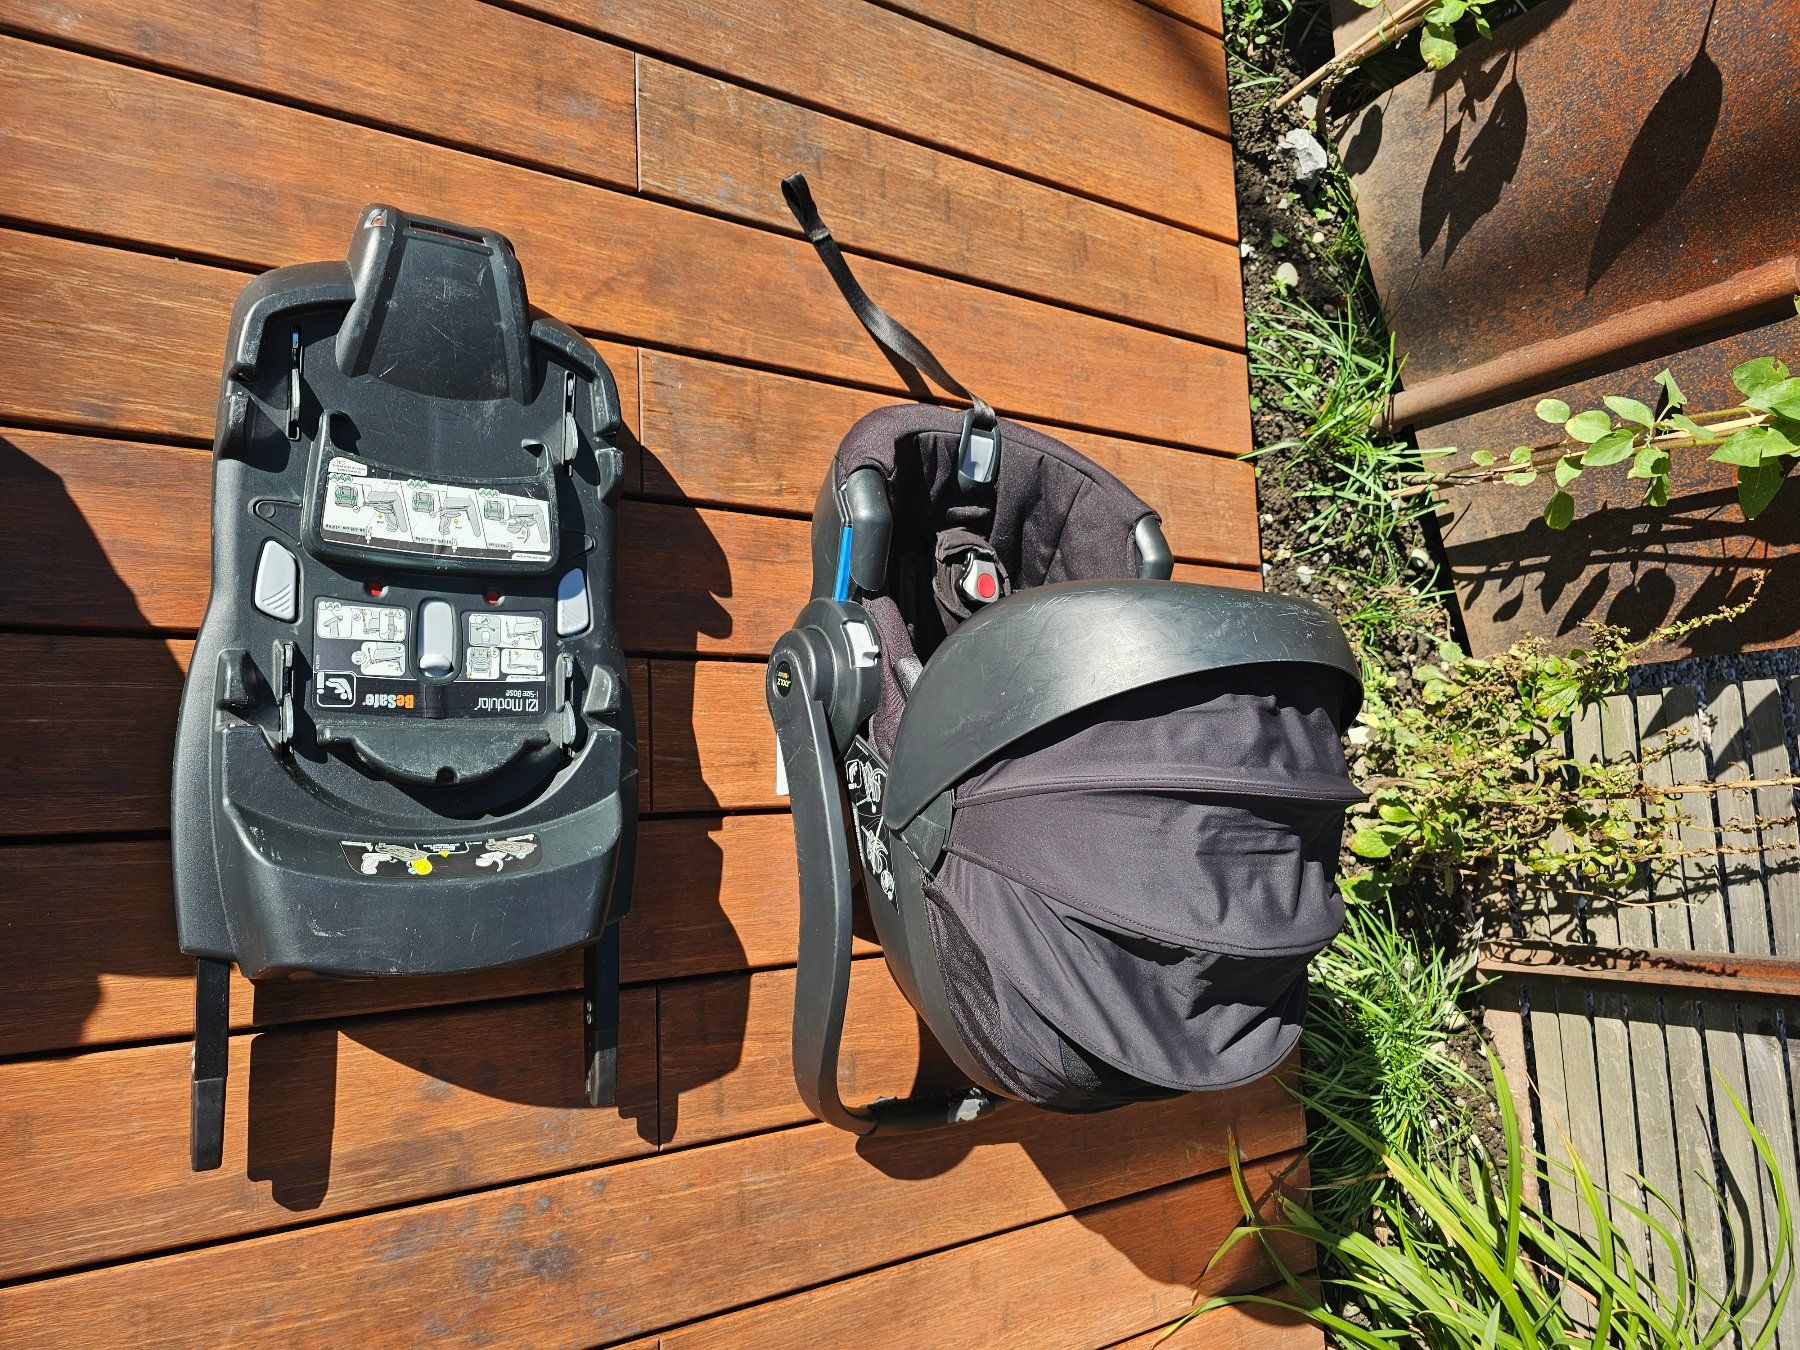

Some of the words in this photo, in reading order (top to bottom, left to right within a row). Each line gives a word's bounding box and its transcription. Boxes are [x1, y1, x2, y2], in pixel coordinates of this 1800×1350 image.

[364, 694, 415, 709] BeSafe
[505, 690, 522, 698] Base
[477, 697, 523, 712] Modular
